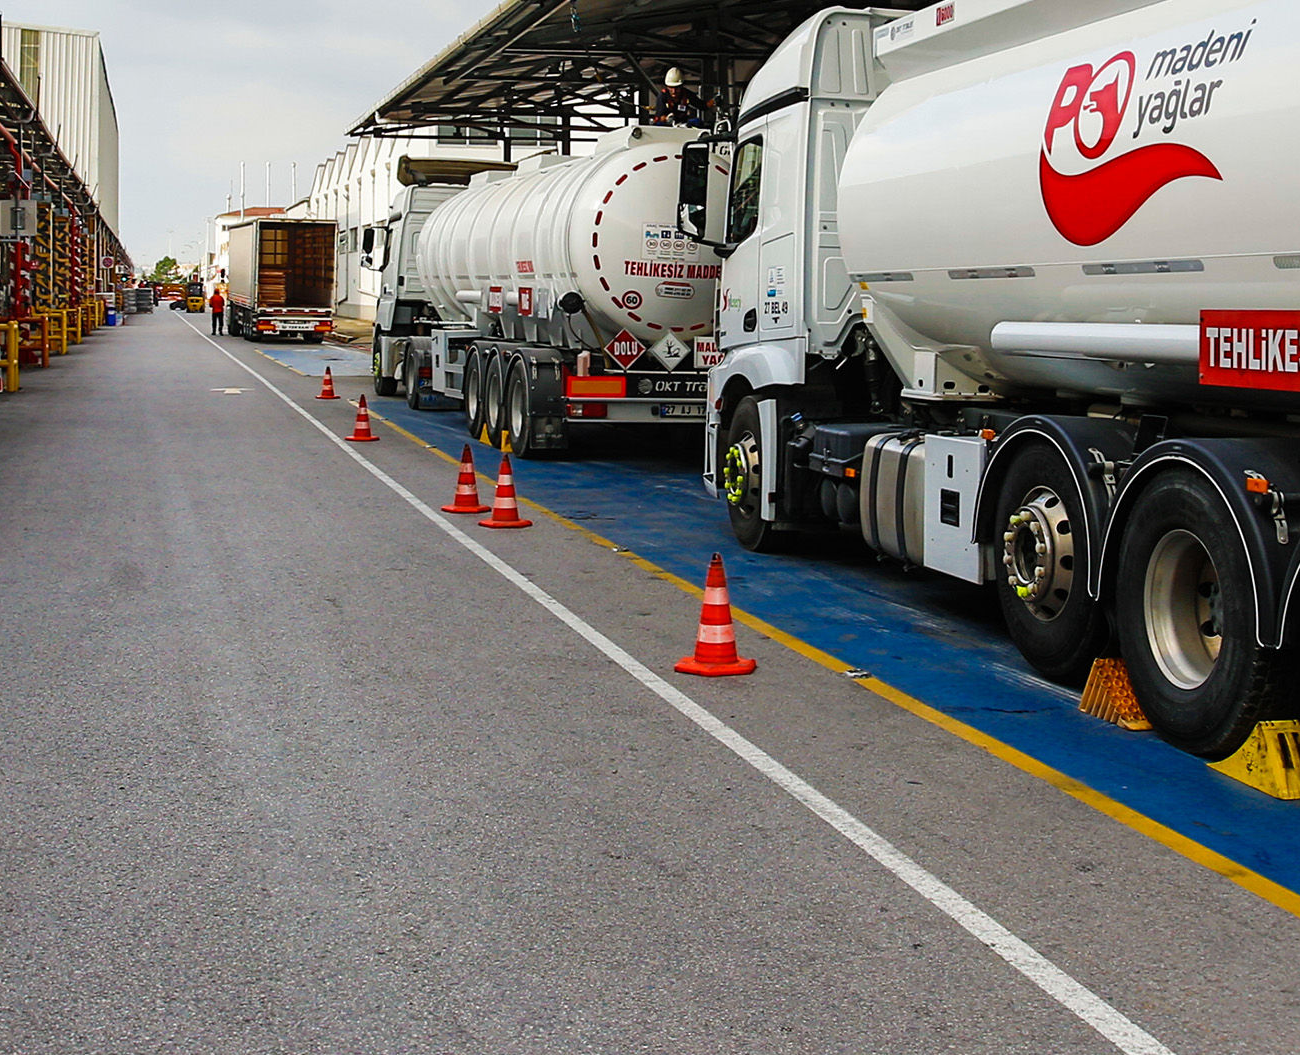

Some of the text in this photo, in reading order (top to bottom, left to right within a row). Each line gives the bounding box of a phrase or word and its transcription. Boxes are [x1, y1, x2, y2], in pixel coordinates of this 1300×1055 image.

[1145, 18, 1257, 82] madeni
[1132, 78, 1224, 139] yağlar
[624, 260, 722, 280] TEHLİKESİZ MADDE
[626, 295, 638, 305] 60
[764, 301, 771, 314] 27
[771, 301, 781, 314] BEL
[614, 341, 638, 356] DOLU
[655, 380, 707, 392] OKT Tra
[665, 405, 676, 415] 27
[681, 406, 692, 415] AJ
